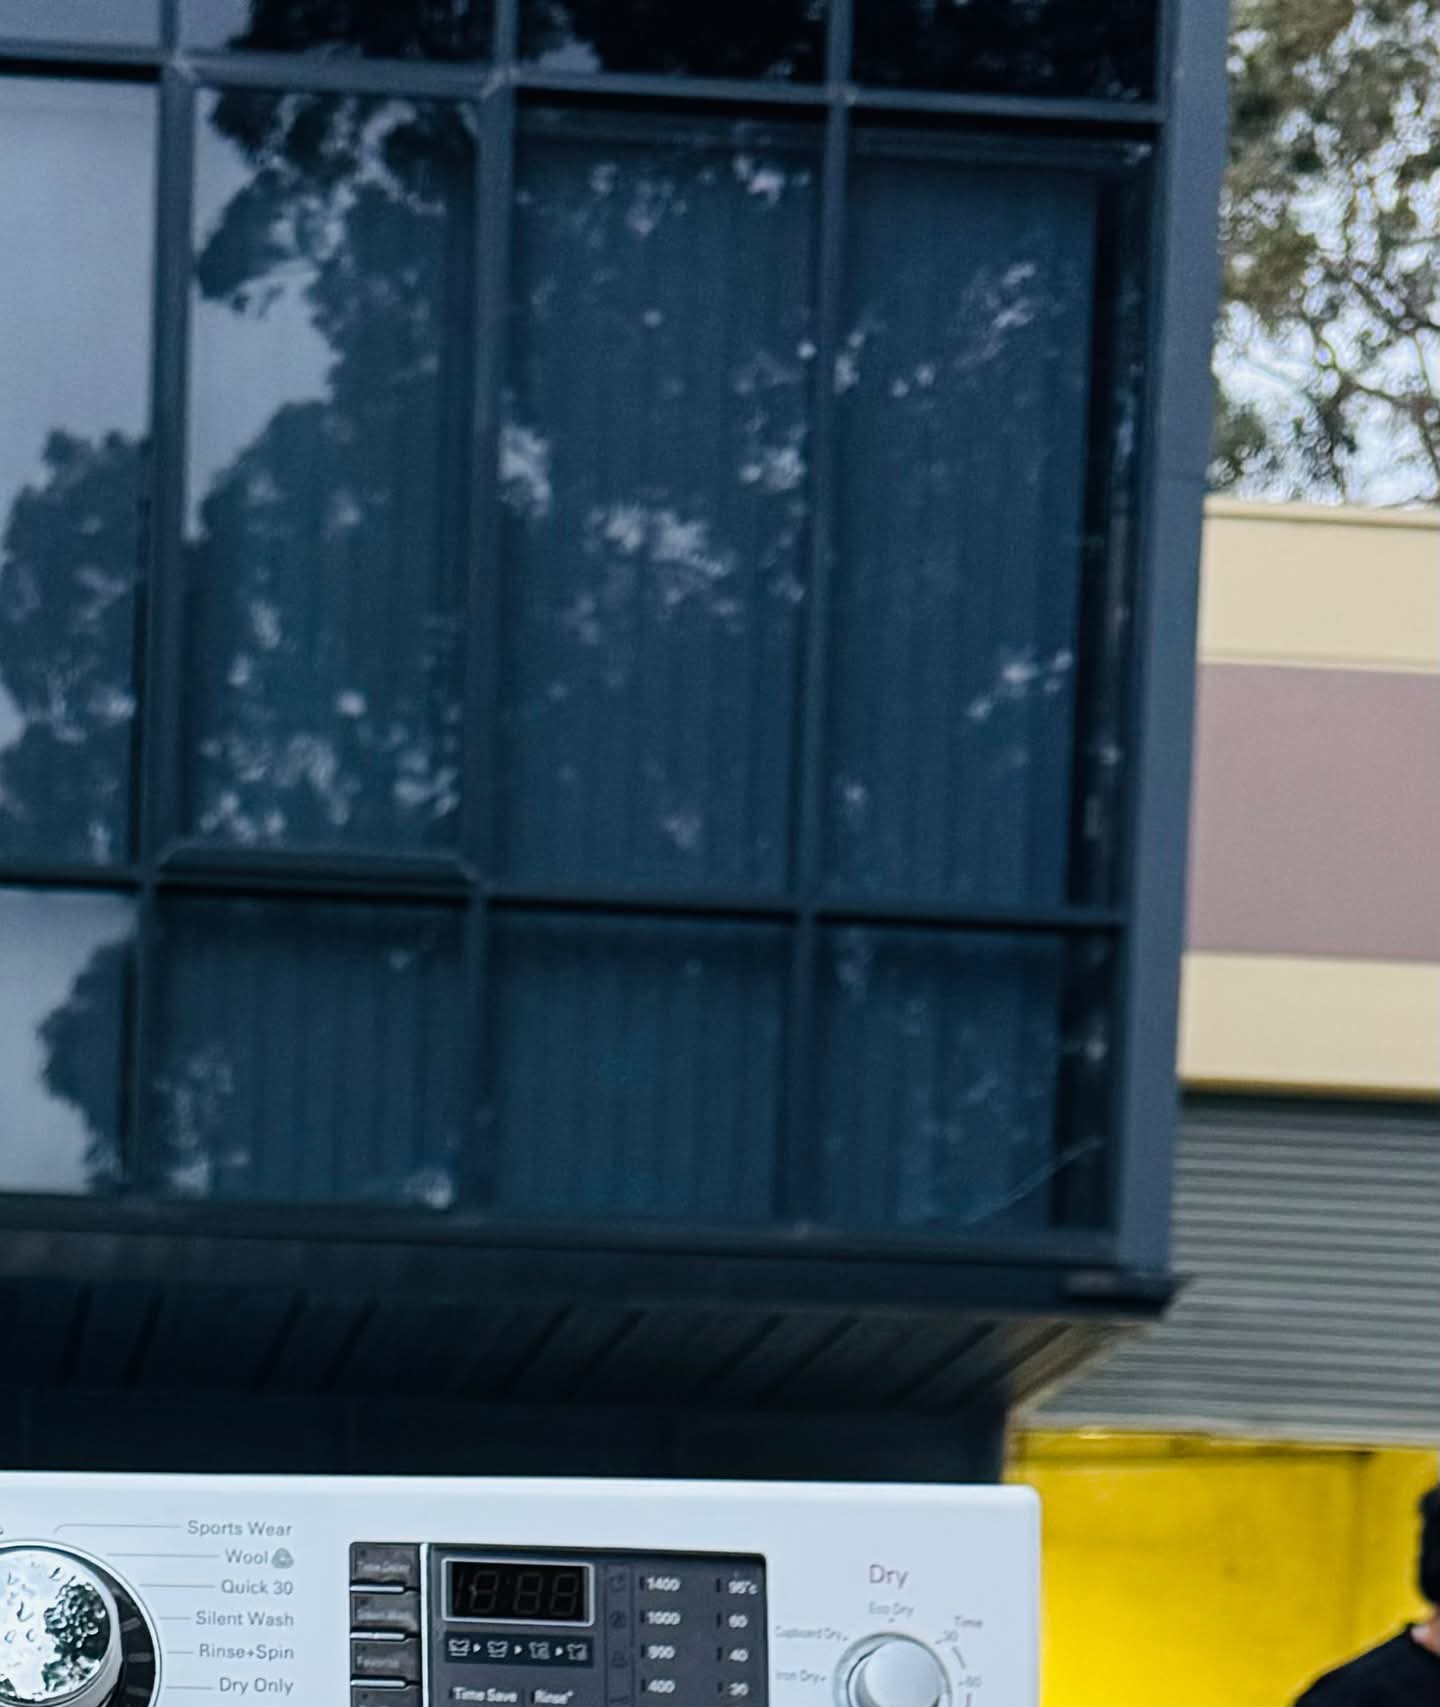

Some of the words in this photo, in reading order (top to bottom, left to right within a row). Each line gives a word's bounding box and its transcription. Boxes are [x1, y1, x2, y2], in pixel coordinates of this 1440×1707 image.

[187, 1519, 244, 1538] Sports
[248, 1521, 293, 1537] Wear
[225, 1548, 269, 1565] Wool
[647, 1576, 681, 1592] 1400
[868, 1563, 910, 1591] Dry
[221, 1578, 269, 1595] Quick
[273, 1580, 294, 1596] 30
[195, 1610, 243, 1626] Silent
[247, 1611, 295, 1627] Wash
[647, 1610, 682, 1626] 1000
[892, 1602, 914, 1618] Dry
[729, 1647, 749, 1663] 40
[219, 1676, 249, 1696] Dry
[253, 1677, 294, 1697] Only
